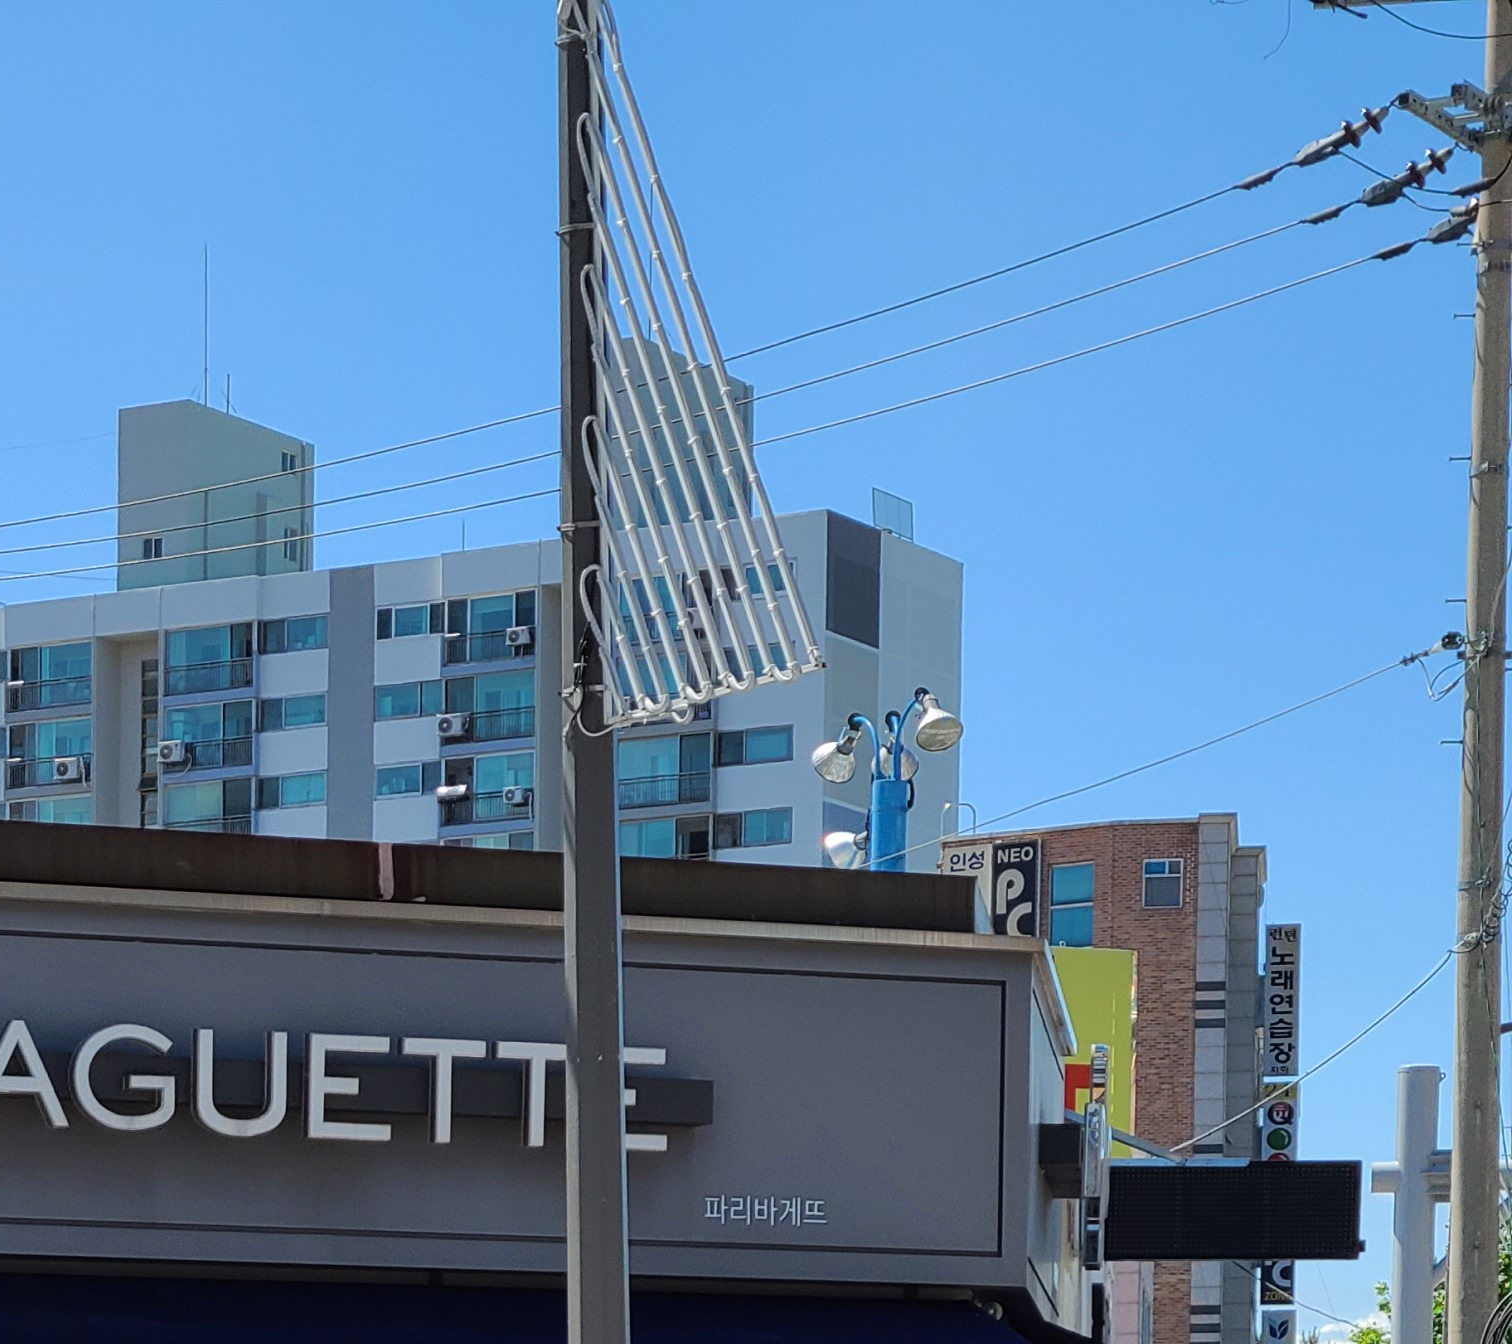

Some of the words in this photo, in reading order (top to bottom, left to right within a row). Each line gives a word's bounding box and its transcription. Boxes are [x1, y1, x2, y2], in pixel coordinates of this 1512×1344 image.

[949, 850, 985, 872] 인성
[997, 846, 1034, 864] NEO
[1269, 946, 1296, 1064] 노래연습장
[704, 1194, 828, 1228] 파리바게뜨
